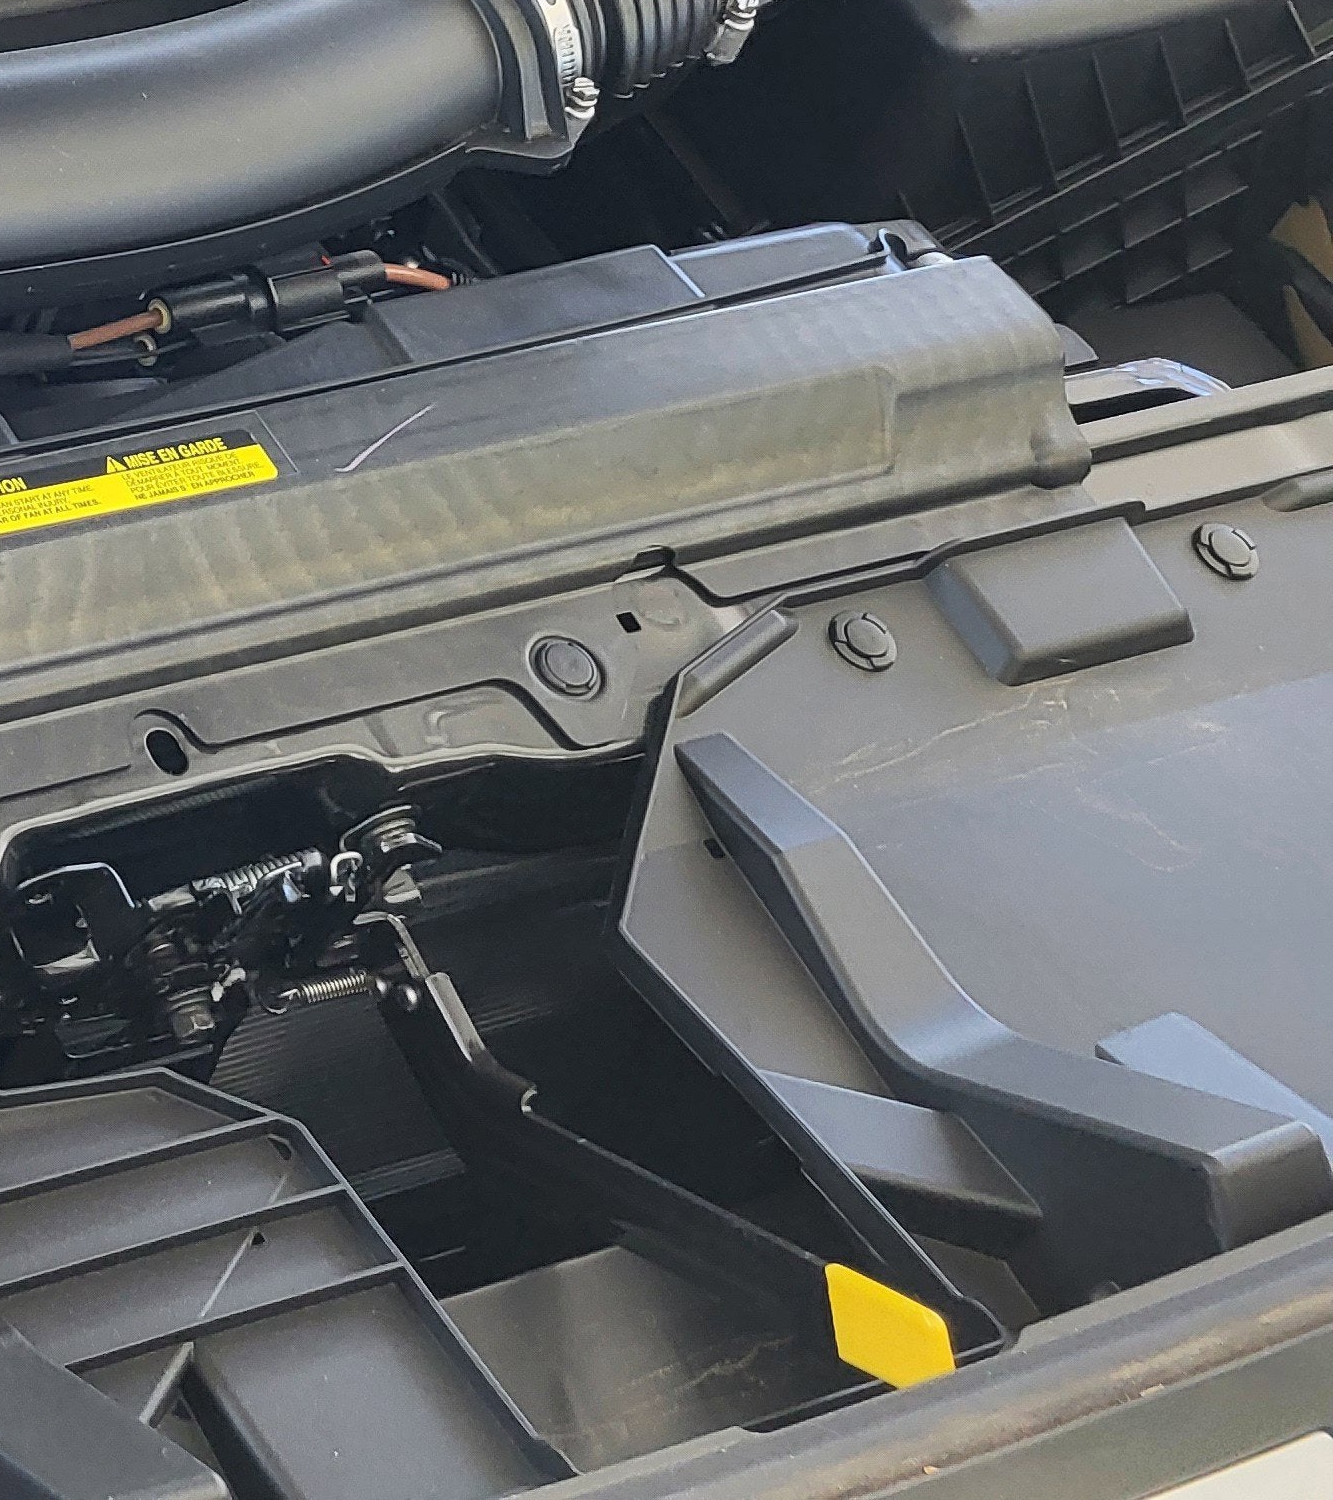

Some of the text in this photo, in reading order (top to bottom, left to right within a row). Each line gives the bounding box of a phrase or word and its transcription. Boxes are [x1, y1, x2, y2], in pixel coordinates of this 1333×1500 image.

[123, 437, 227, 469] MISE EN GARDE
[122, 473, 133, 481] LE
[225, 452, 236, 460] DE
[14, 495, 41, 506] START
[42, 492, 53, 501] AT
[53, 489, 70, 498] ANY
[10, 514, 21, 522] OF
[24, 510, 41, 520] FAN
[43, 508, 53, 516] AT
[55, 505, 71, 514] ALL
